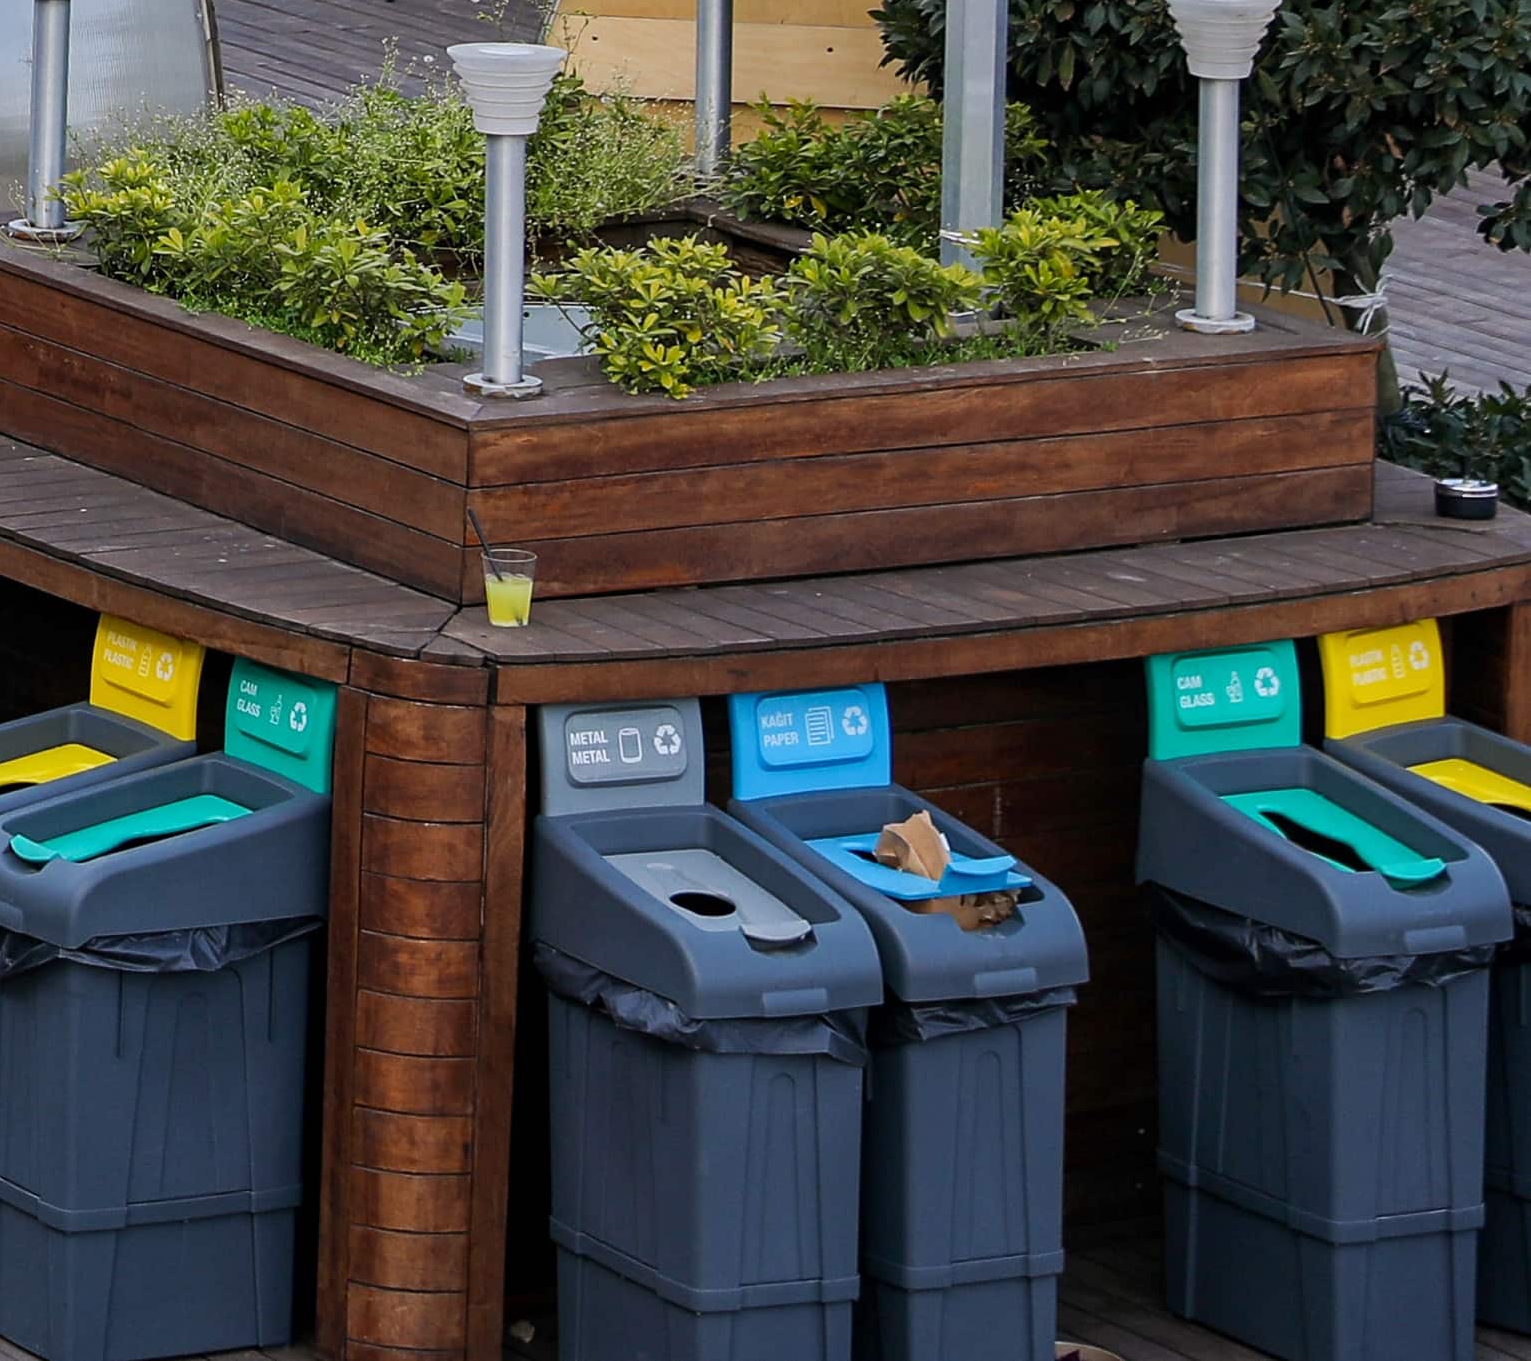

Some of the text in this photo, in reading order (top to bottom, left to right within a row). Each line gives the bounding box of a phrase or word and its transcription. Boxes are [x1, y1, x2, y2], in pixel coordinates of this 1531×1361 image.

[239, 679, 258, 696] CAM
[1176, 675, 1203, 690] CAM
[236, 698, 262, 719] GLASS
[1179, 692, 1215, 709] GLASS
[570, 730, 608, 747] METAL
[763, 731, 799, 747] PAPER
[572, 749, 610, 765] METAL
